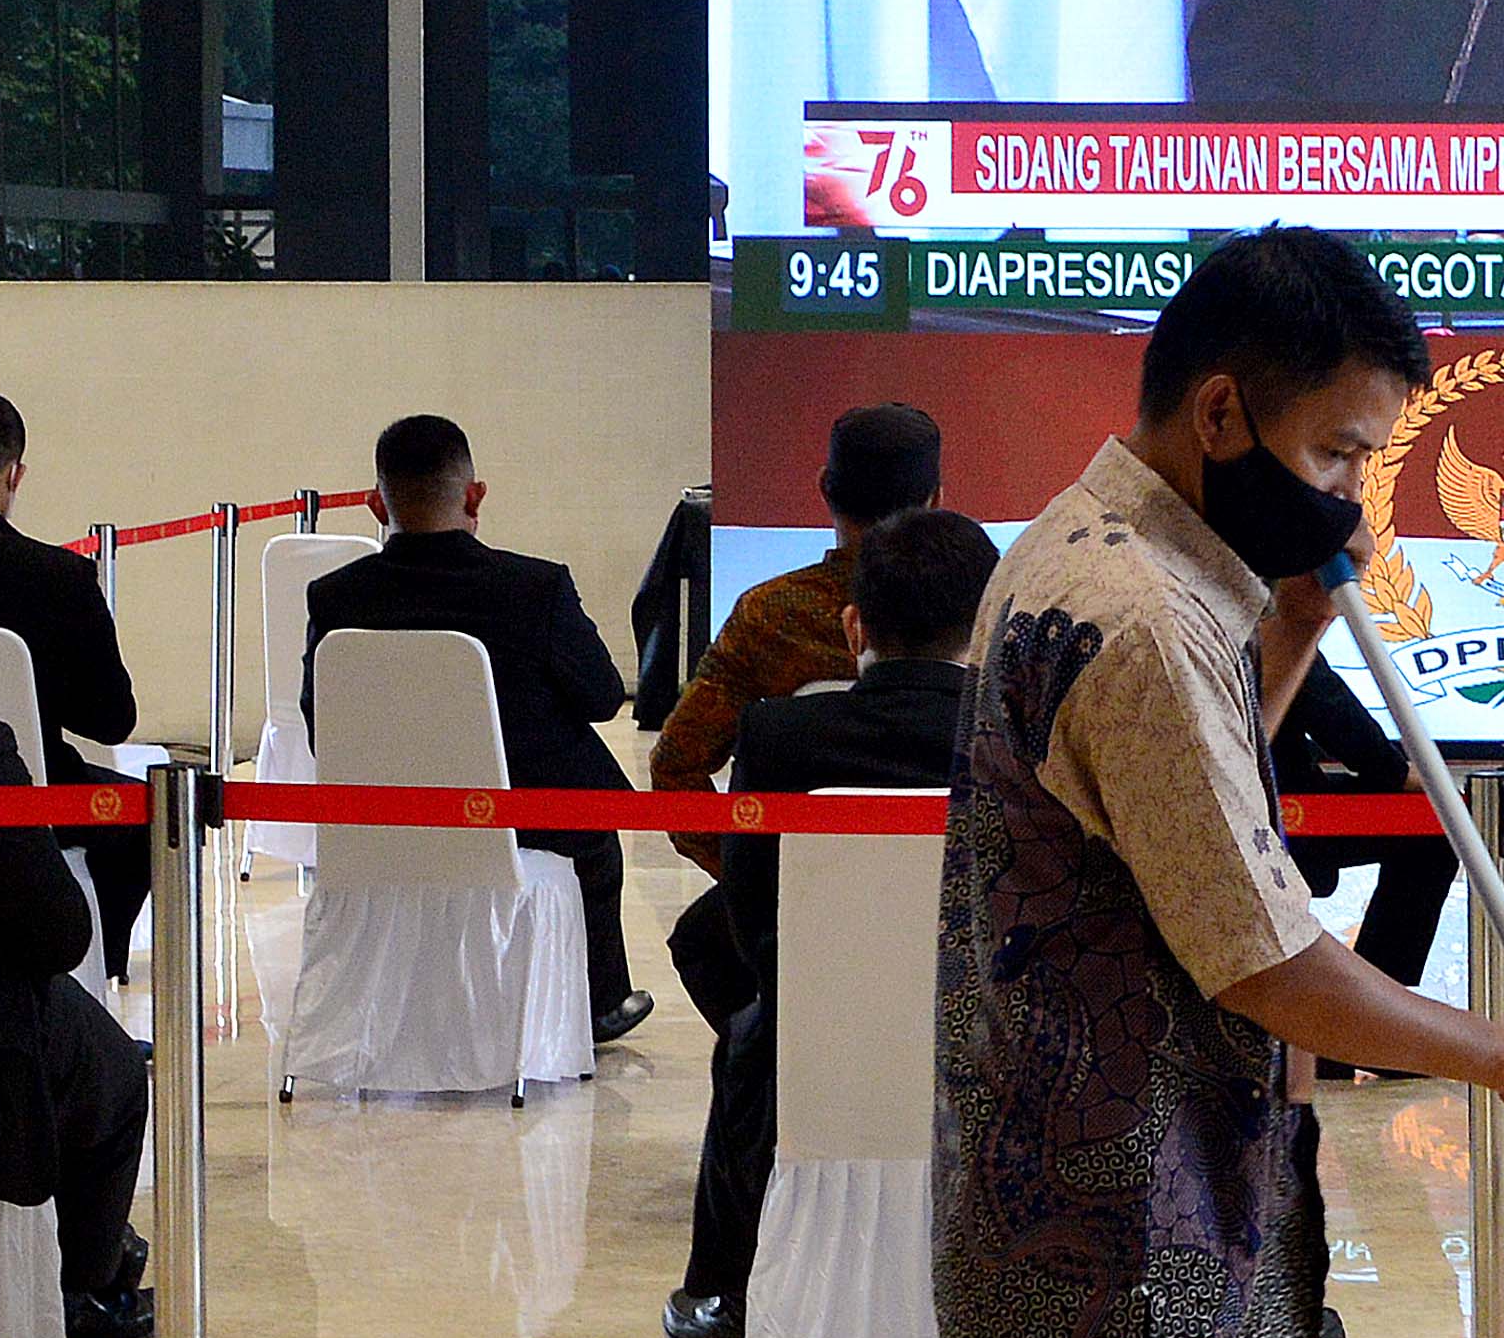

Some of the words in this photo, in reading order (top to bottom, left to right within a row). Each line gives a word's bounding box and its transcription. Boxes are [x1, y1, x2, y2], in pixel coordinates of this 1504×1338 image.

[910, 131, 928, 142] TH
[858, 131, 927, 216] 76
[975, 135, 1100, 191] SIDANG
[1109, 135, 1267, 191] TAHUNAN
[1278, 135, 1441, 192] BERSAMA
[789, 251, 880, 298] 9:45
[927, 251, 1193, 298] DIAPRESIASI
